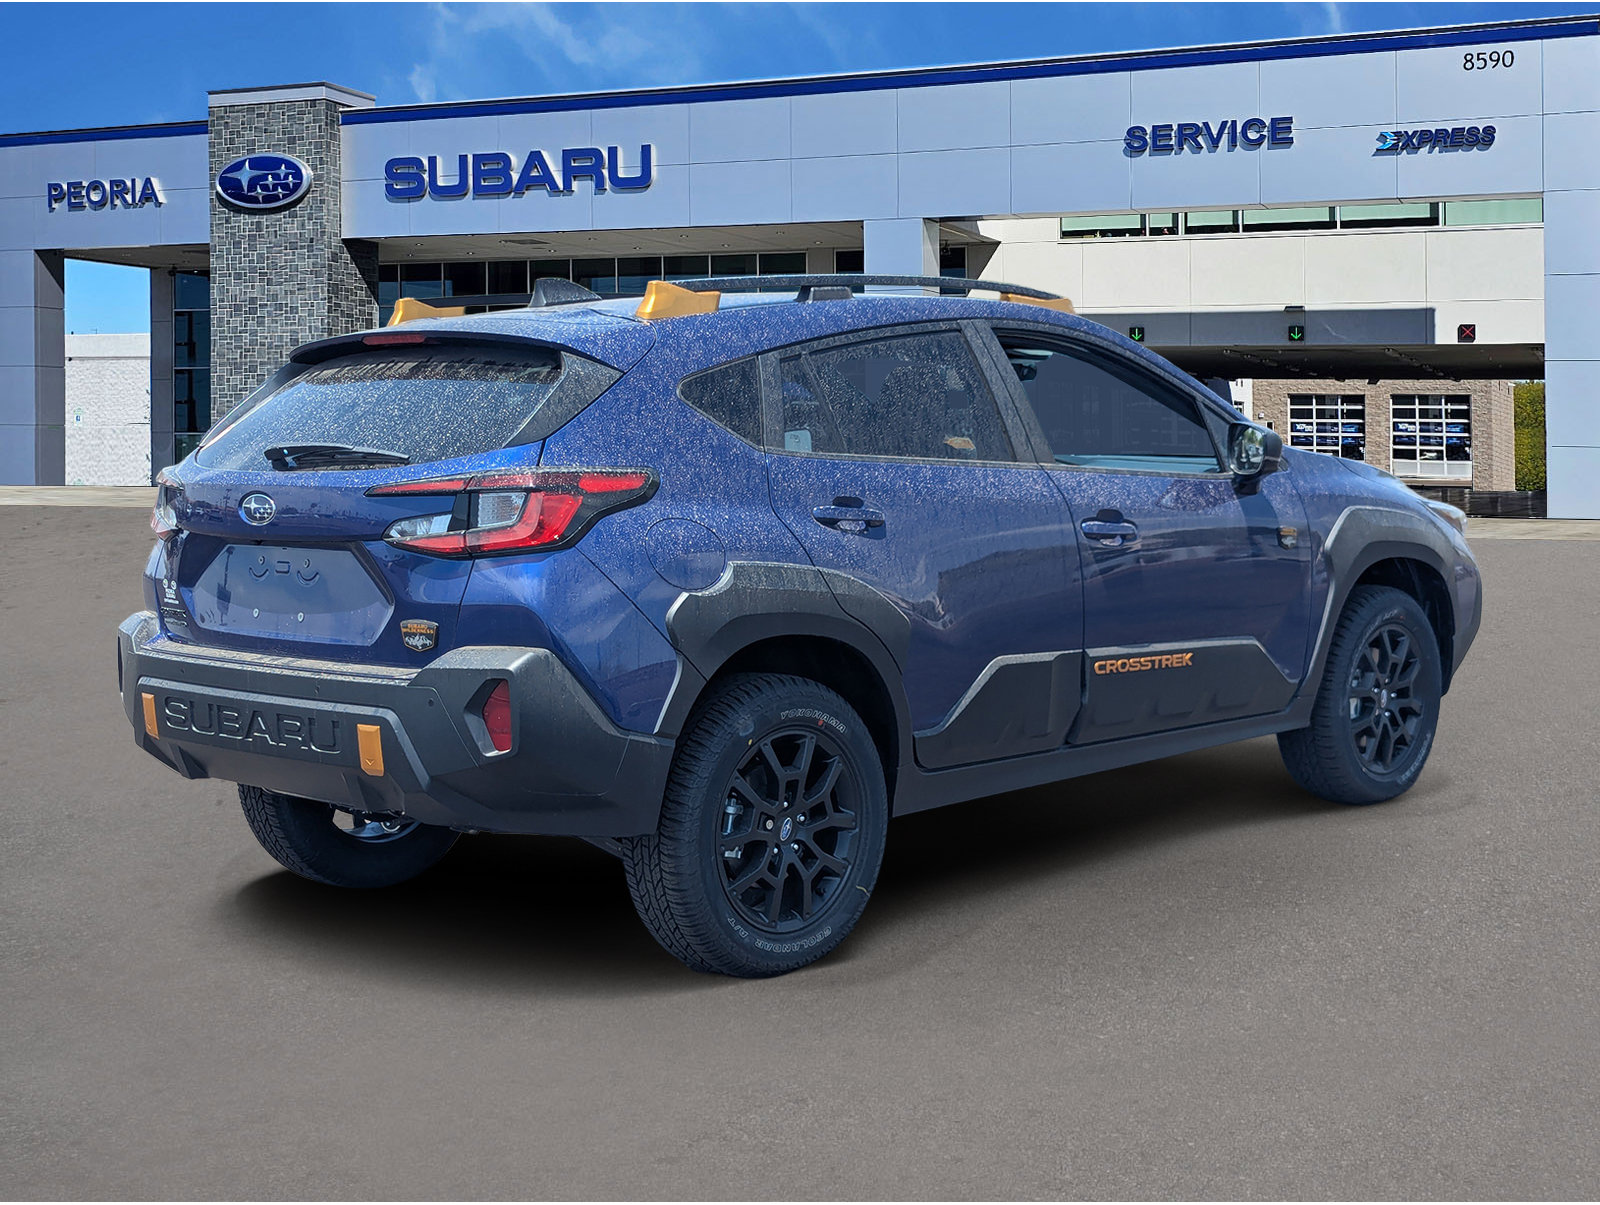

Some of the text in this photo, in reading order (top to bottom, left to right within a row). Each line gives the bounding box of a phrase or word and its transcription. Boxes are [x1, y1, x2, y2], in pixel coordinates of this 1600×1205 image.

[1462, 50, 1515, 72] 8590
[1124, 116, 1294, 155] SERVICE
[1375, 125, 1497, 151] EXPRESS
[384, 143, 654, 201] SUBARU
[47, 176, 163, 211] PEORIA
[1094, 652, 1193, 675] CROSSTREK
[164, 696, 342, 755] SUBARU
[780, 708, 847, 733] YOKOHAMA
[726, 914, 833, 953] GEOLANDAR A/T
